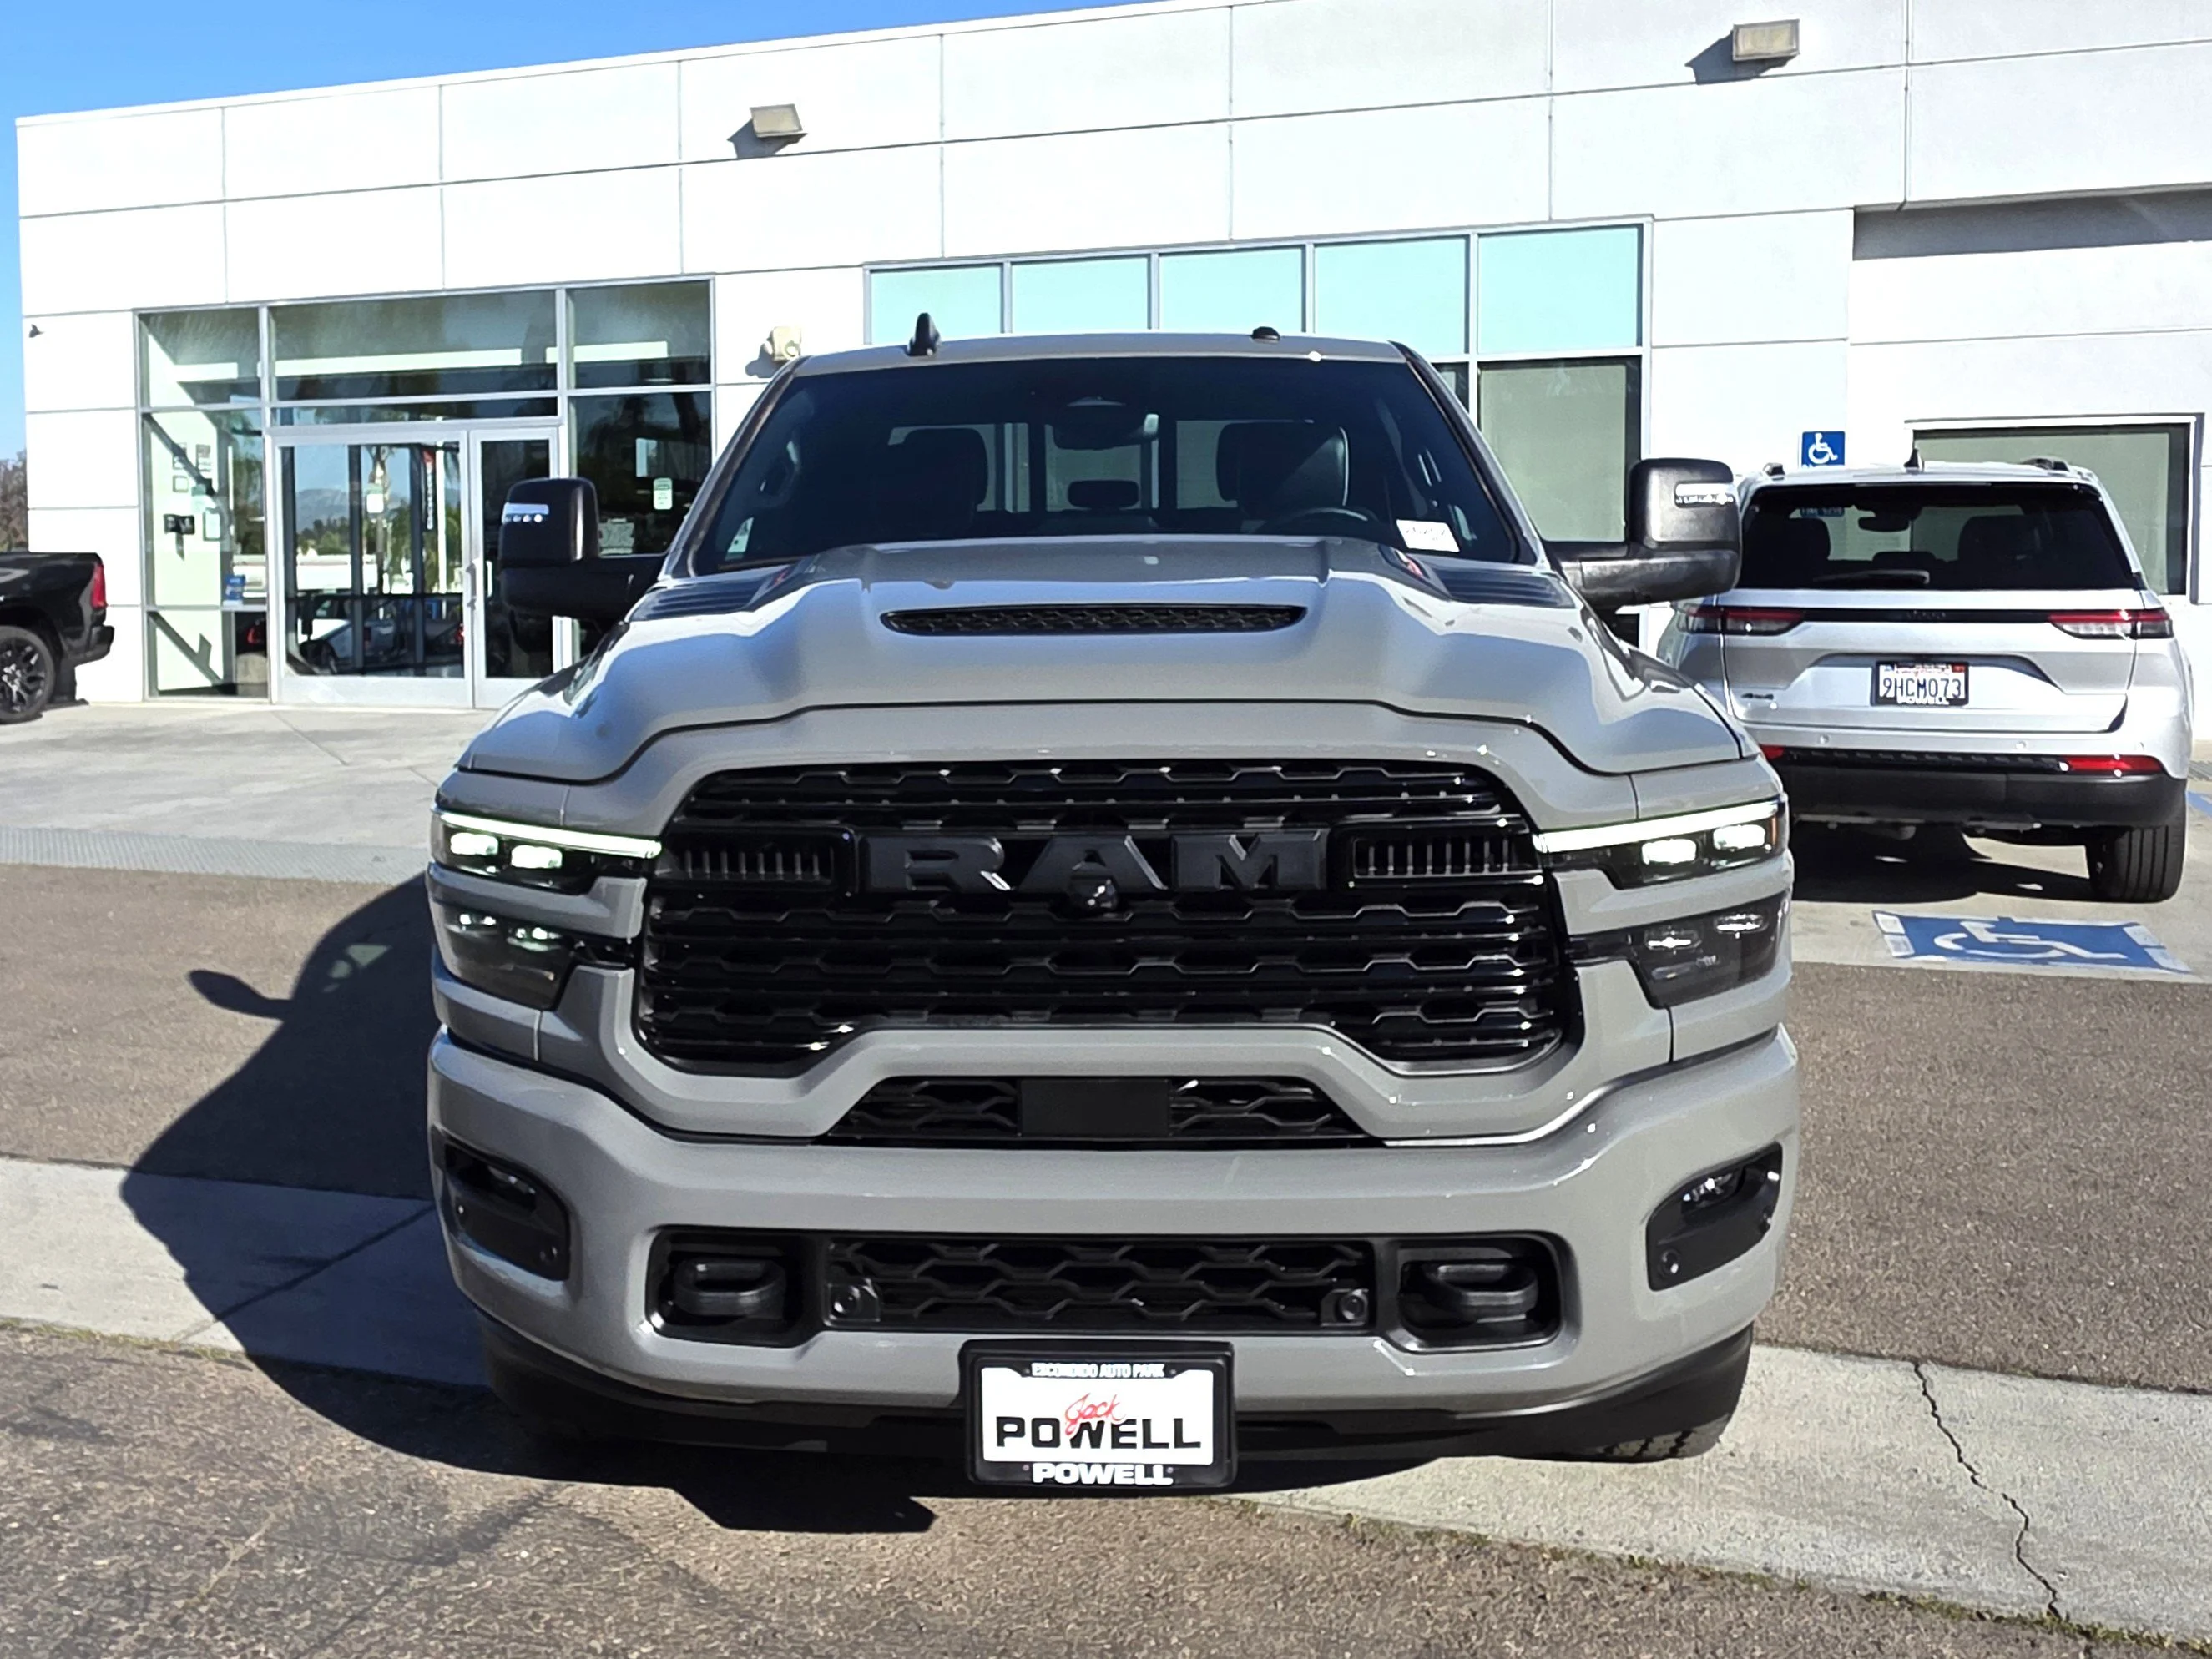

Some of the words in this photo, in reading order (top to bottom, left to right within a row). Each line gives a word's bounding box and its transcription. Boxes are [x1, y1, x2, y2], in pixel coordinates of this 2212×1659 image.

[1883, 678, 1962, 698] 9HCM073
[863, 835, 1325, 893] RAM
[1100, 1364, 1131, 1378] AUTO
[1133, 1364, 1164, 1378] PARK
[1065, 1393, 1125, 1435] Jack
[996, 1416, 1201, 1449] POWELL
[1033, 1463, 1173, 1485] POWELL
